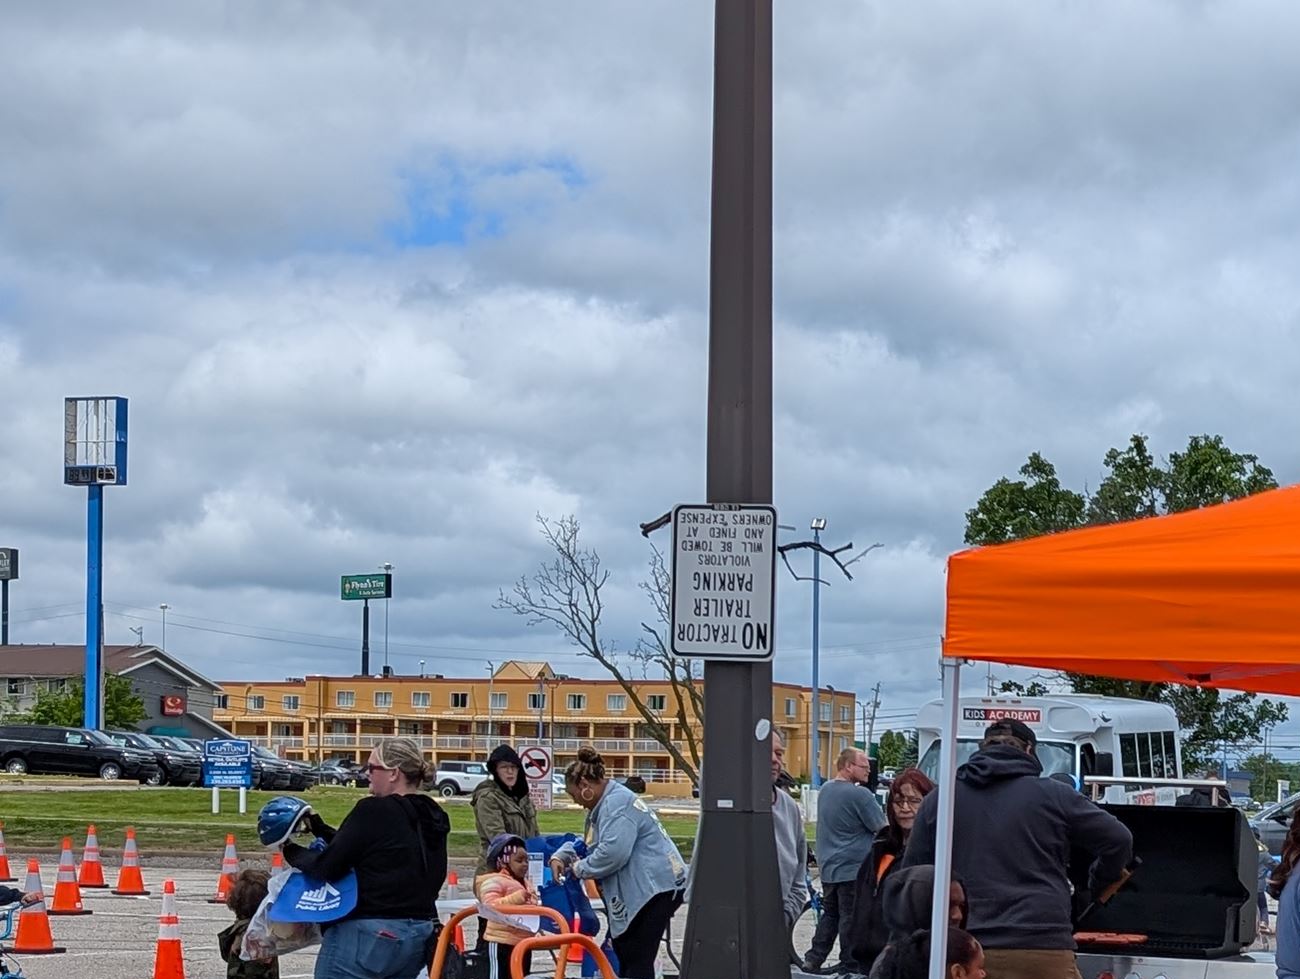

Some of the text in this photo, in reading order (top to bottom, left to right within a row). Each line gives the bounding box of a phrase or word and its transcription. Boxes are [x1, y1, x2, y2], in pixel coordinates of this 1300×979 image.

[681, 513, 725, 525] EXPENSE
[686, 526, 764, 539] AND FINED AT
[682, 540, 763, 553] WILL BE TOWED
[698, 554, 751, 566] VIOLATORS
[693, 572, 753, 592] PARKING
[694, 598, 751, 618] TRAILER
[678, 622, 767, 650] NO TRACTOR
[964, 710, 1039, 721] KIDS ACADEMY
